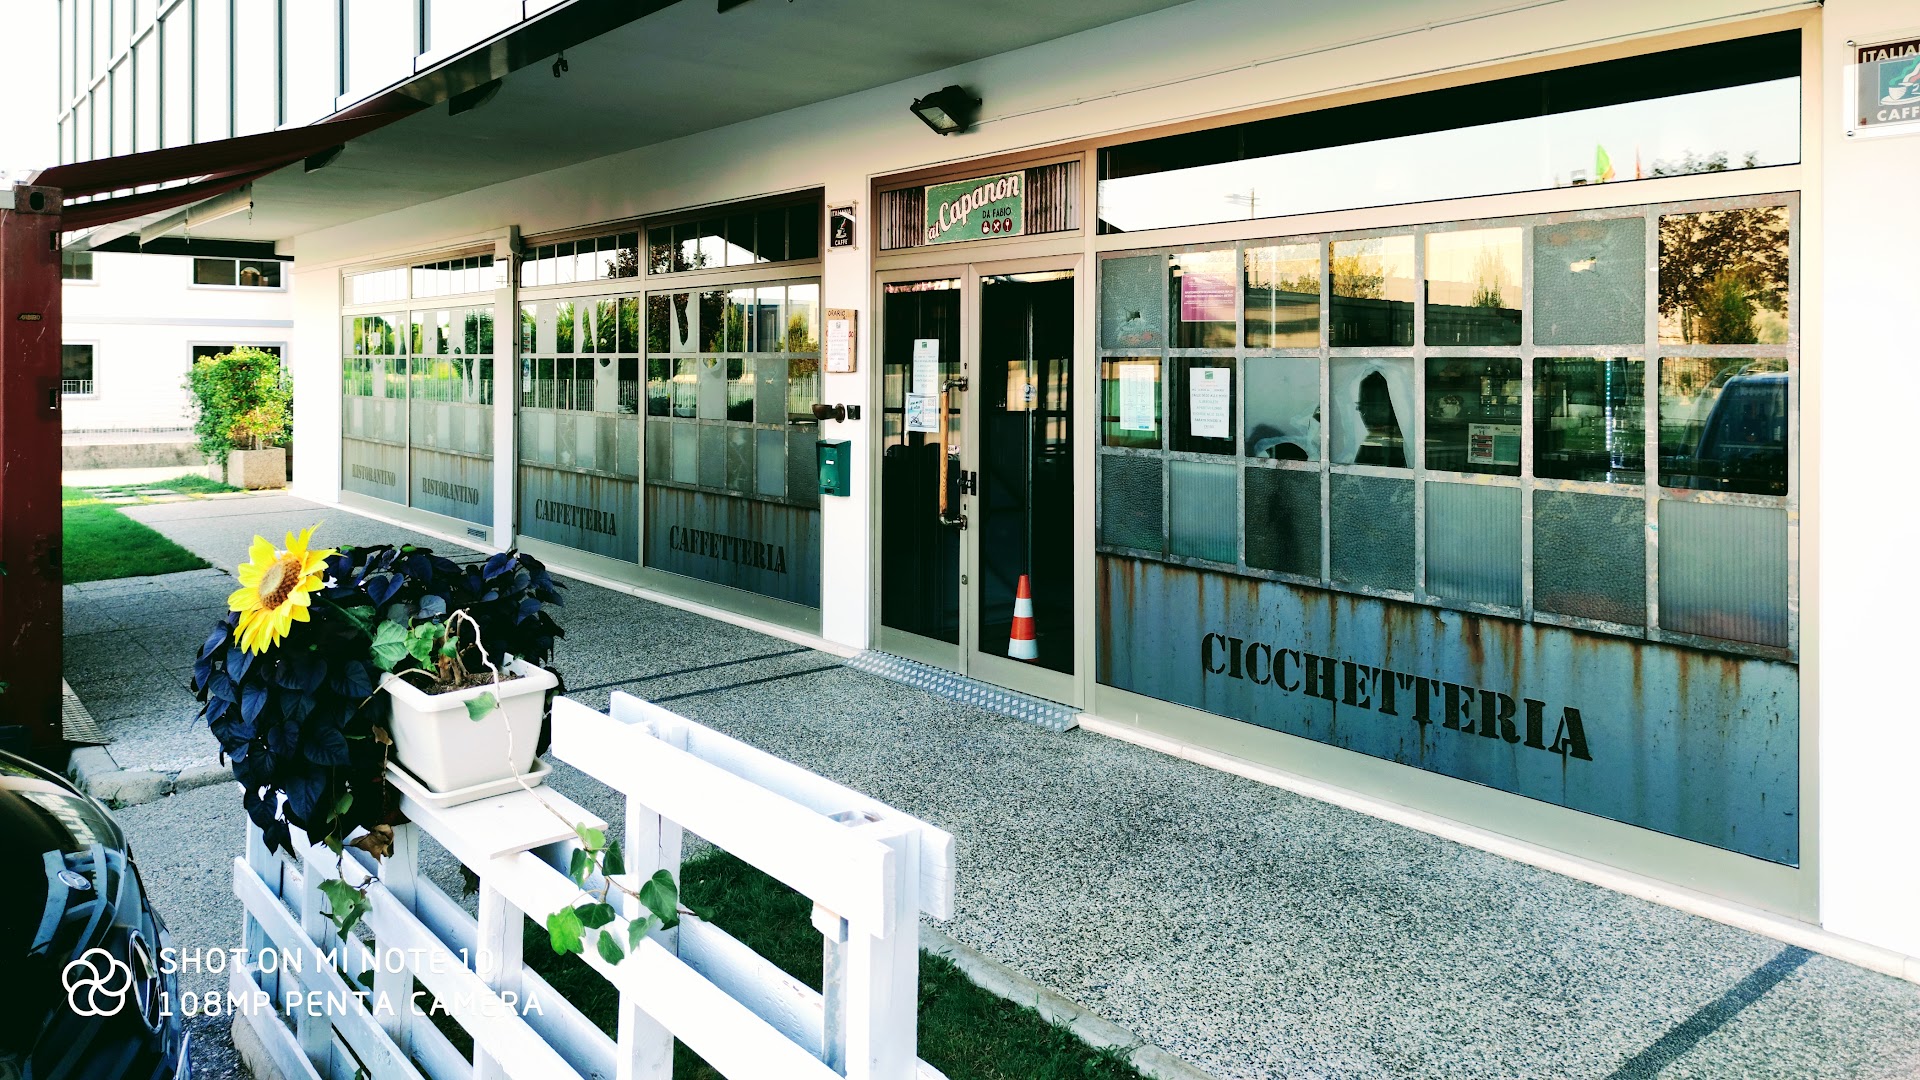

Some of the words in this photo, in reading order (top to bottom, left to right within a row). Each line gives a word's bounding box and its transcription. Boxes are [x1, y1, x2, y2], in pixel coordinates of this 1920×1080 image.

[928, 220, 940, 240] al
[939, 174, 1020, 227] Capanon
[982, 210, 991, 219] DA
[992, 206, 1012, 218] FABIO
[352, 464, 396, 487] RISTORANTINO
[422, 477, 479, 505] RISTORANTINO
[535, 498, 617, 536] CAFFETTERIA
[669, 525, 787, 574] CAFFETTERIA
[1201, 632, 1593, 762] CICCHETTERIA
